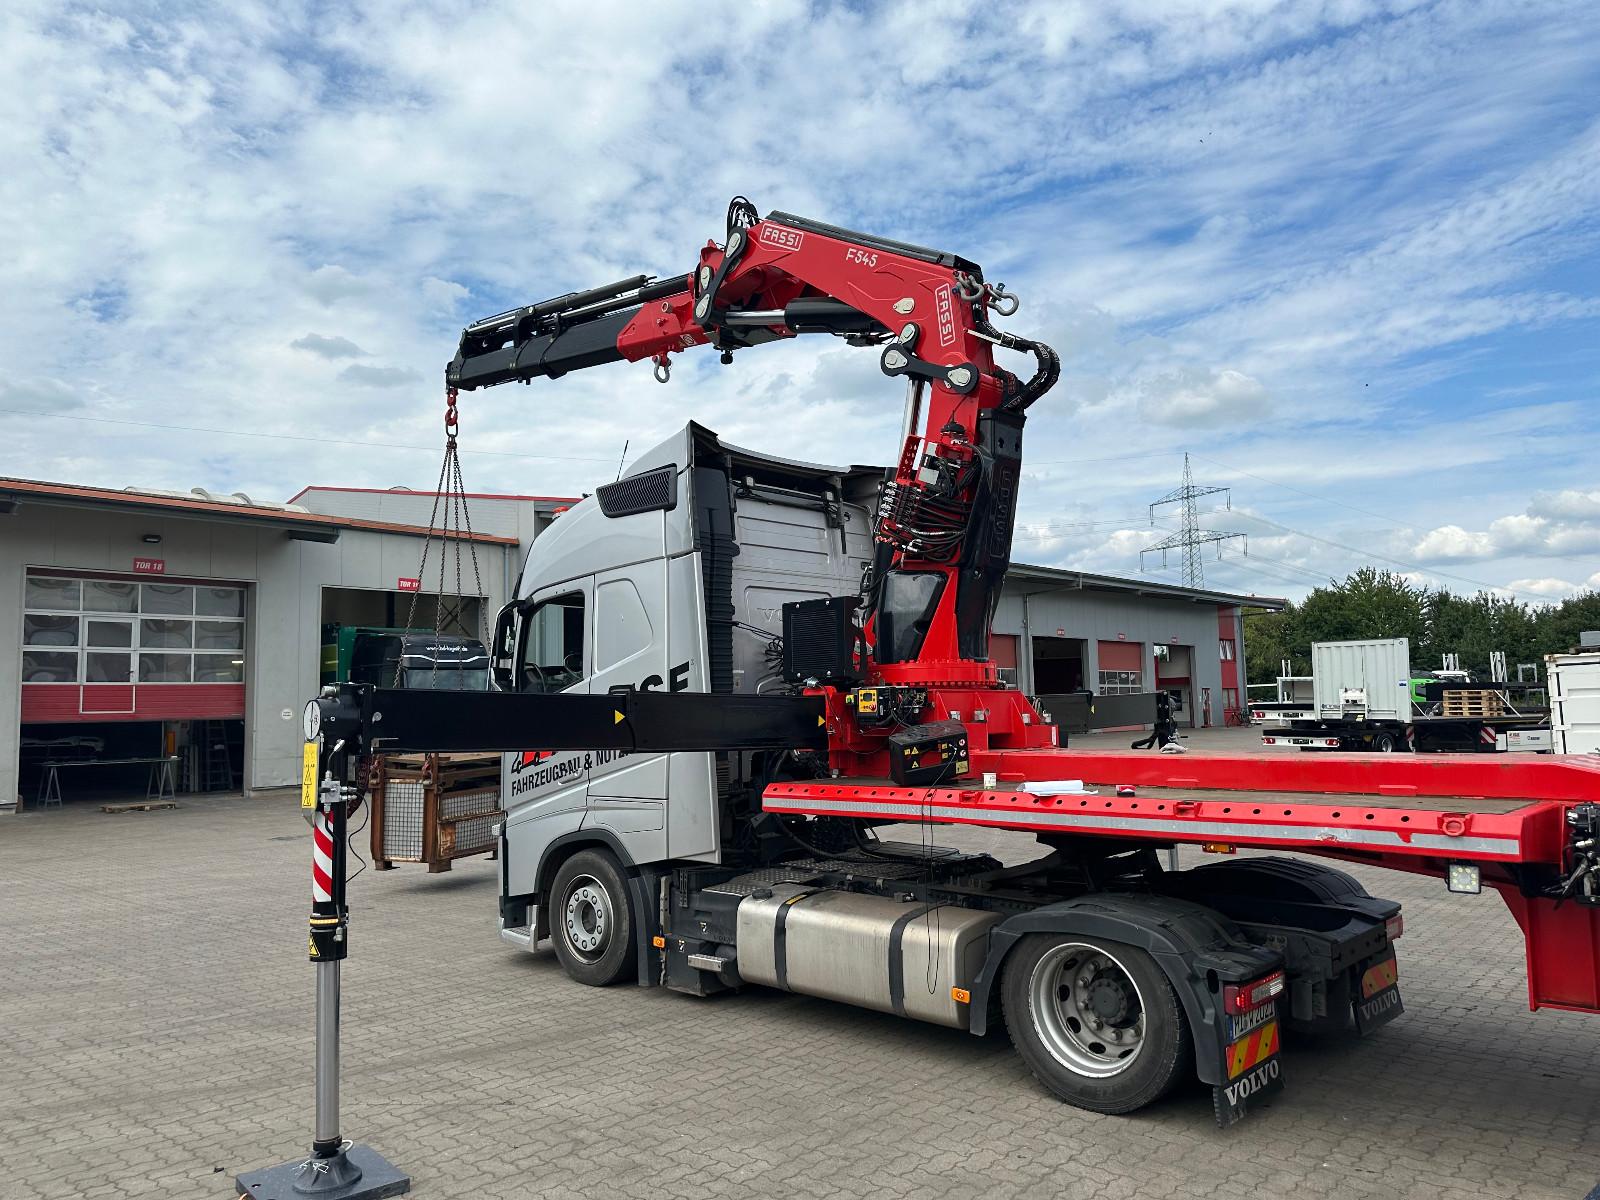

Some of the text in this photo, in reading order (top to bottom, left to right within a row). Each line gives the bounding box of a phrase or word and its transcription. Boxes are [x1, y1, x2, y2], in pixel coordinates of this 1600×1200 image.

[763, 227, 800, 247] FASSI
[845, 246, 879, 267] F545
[938, 290, 953, 341] FASSI
[135, 561, 151, 570] TOR
[400, 580, 411, 588] TOR
[511, 756, 582, 797] FAHRZEUGBAU
[583, 753, 593, 770] &
[1360, 989, 1398, 1020] VOLVO
[1224, 1060, 1279, 1106] VOLVO
